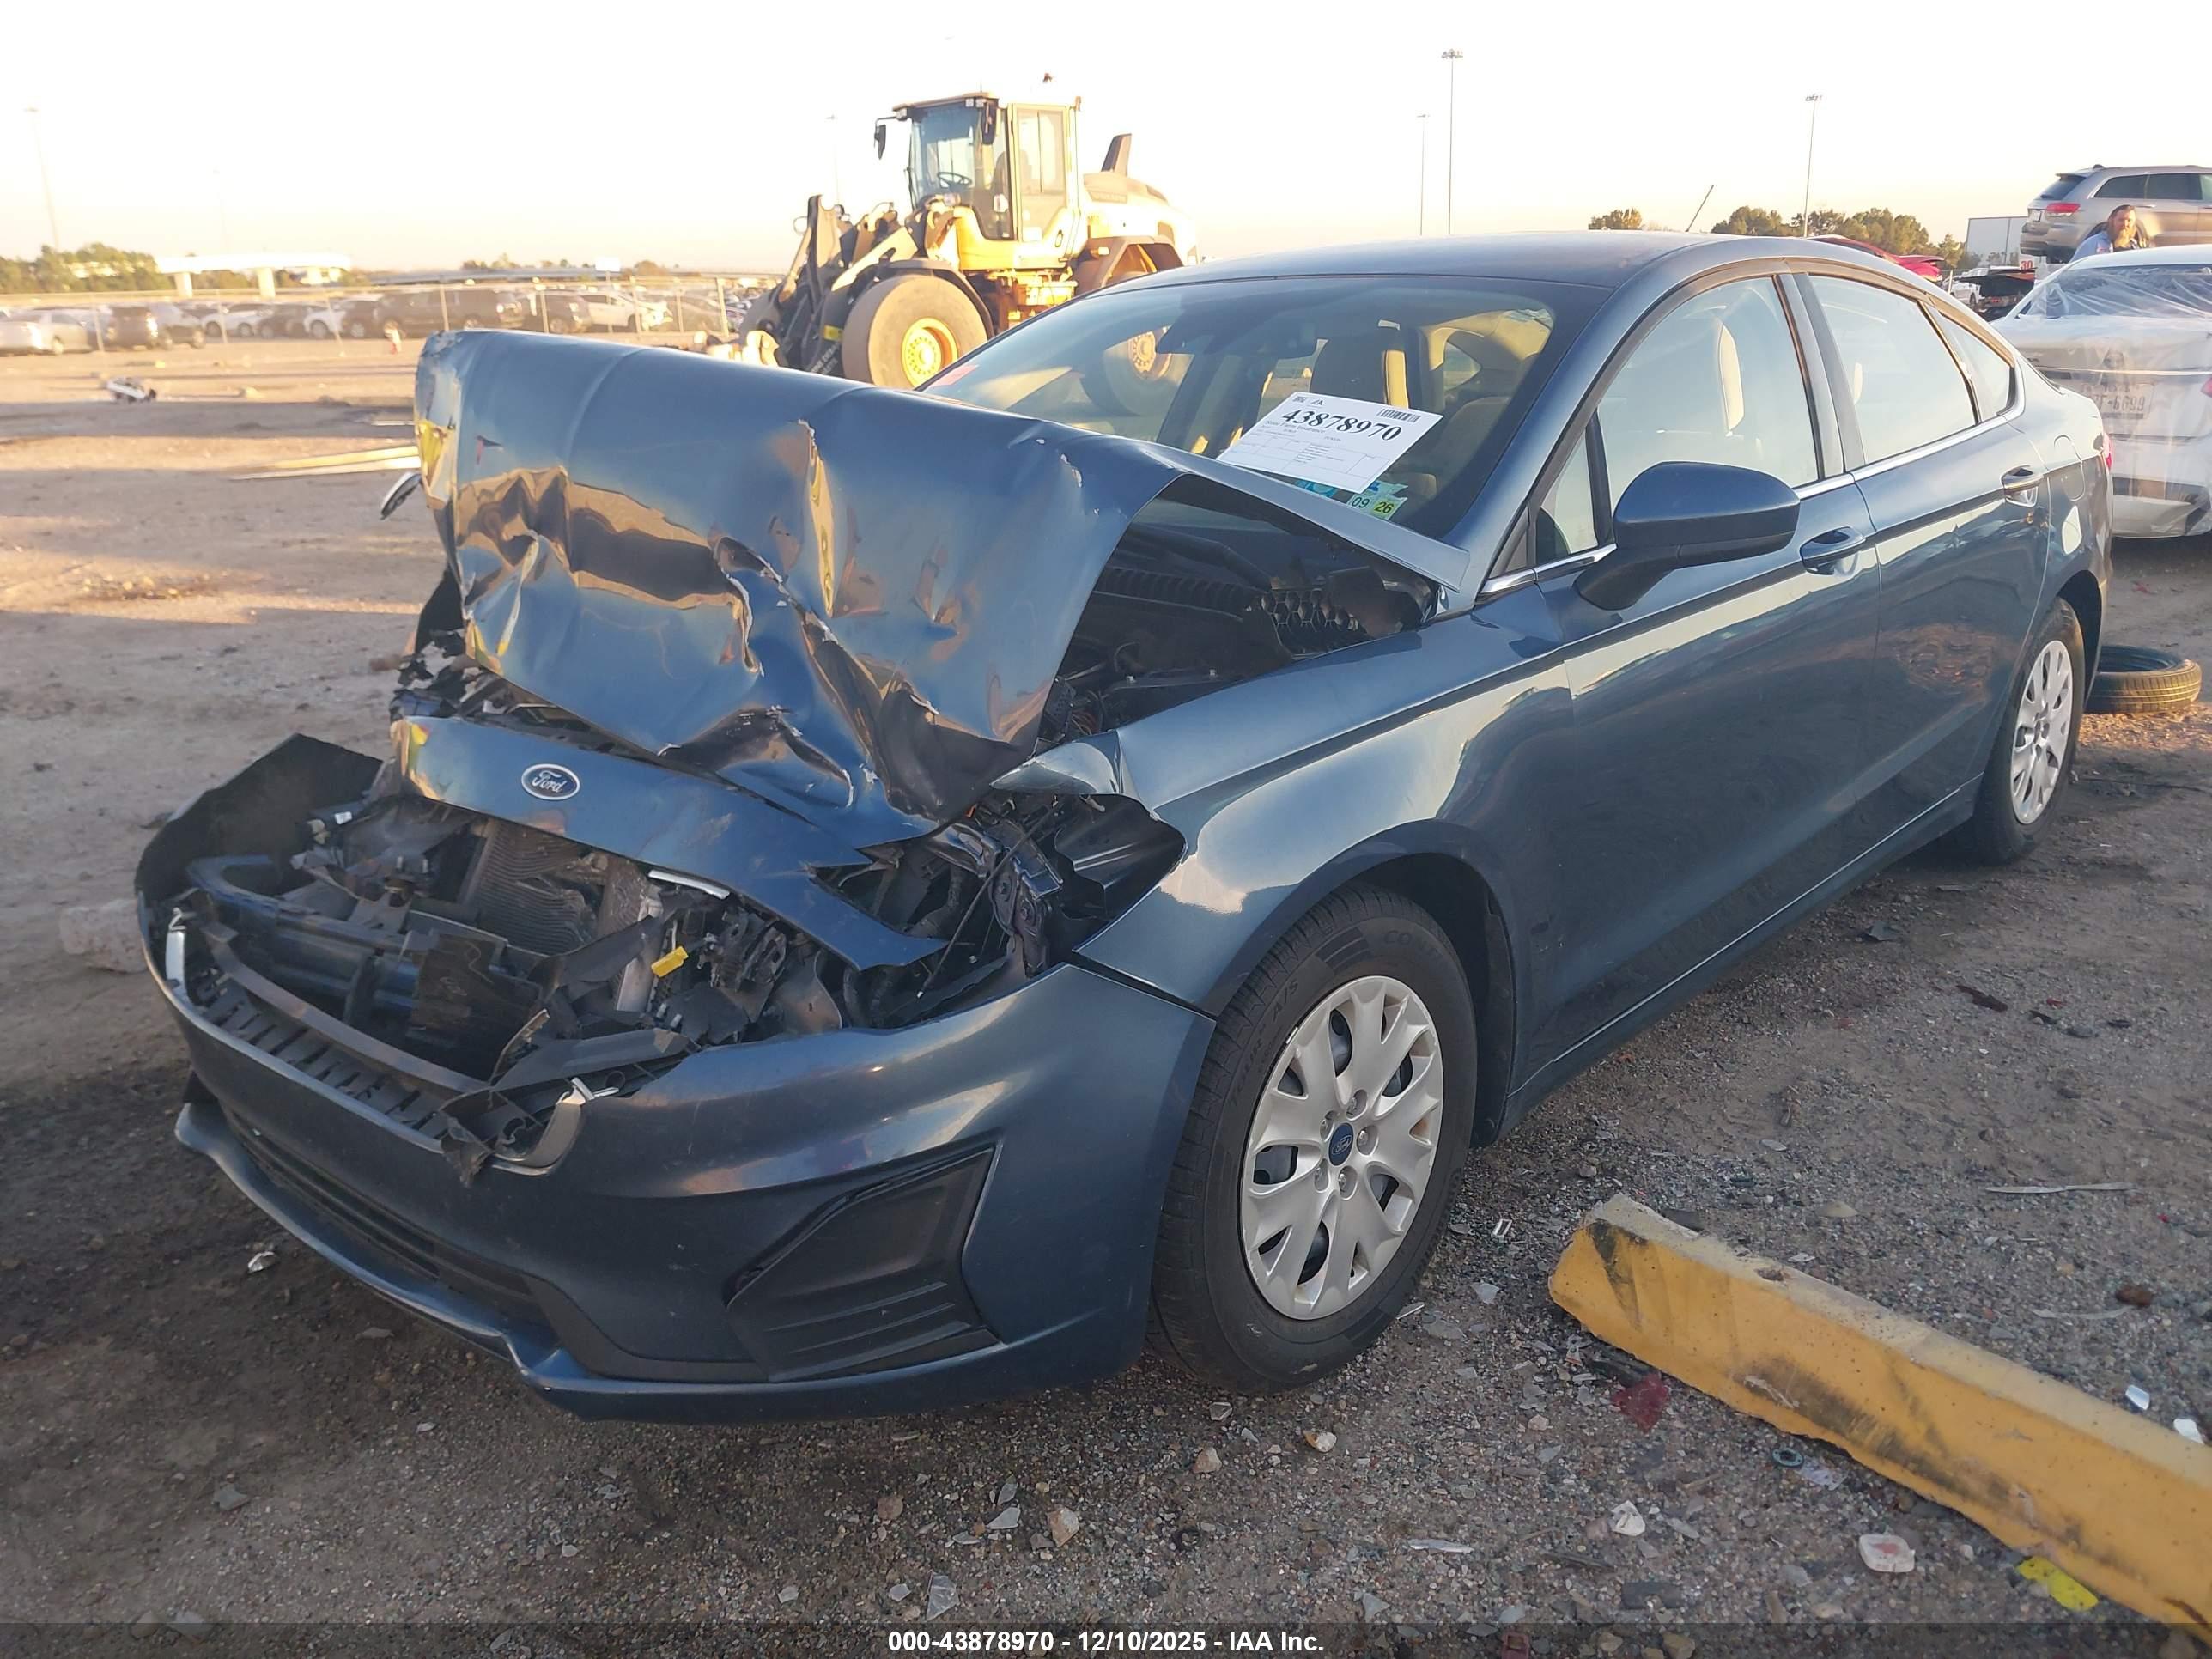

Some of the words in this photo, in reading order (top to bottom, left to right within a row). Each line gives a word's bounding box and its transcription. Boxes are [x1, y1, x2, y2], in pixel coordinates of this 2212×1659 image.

[1282, 409, 1402, 441] 43878970
[1352, 496, 1370, 508] 09
[1374, 501, 1395, 514] 26
